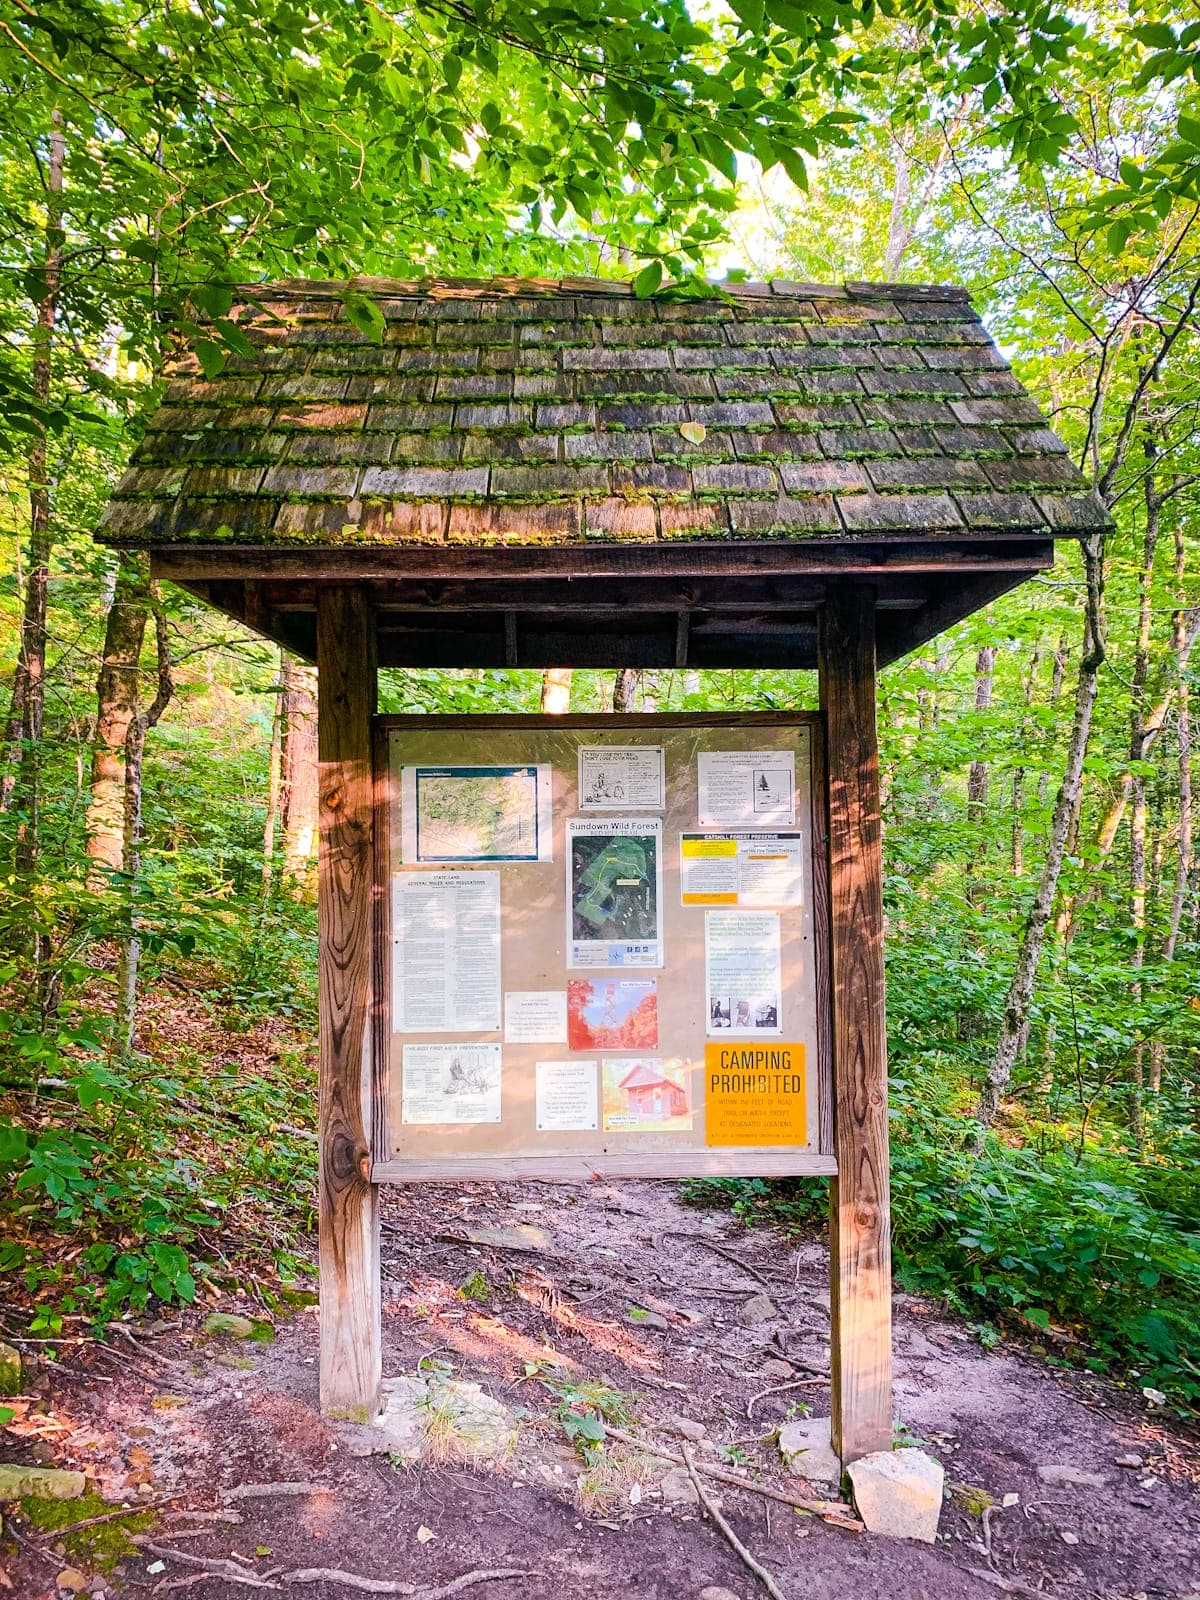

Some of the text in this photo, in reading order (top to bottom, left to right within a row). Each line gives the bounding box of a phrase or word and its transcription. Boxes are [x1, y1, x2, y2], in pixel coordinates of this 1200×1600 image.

[569, 822, 658, 831] Sundown Wild Forest
[720, 1050, 791, 1070] CAMPING
[711, 1074, 801, 1094] PROHIBITED
